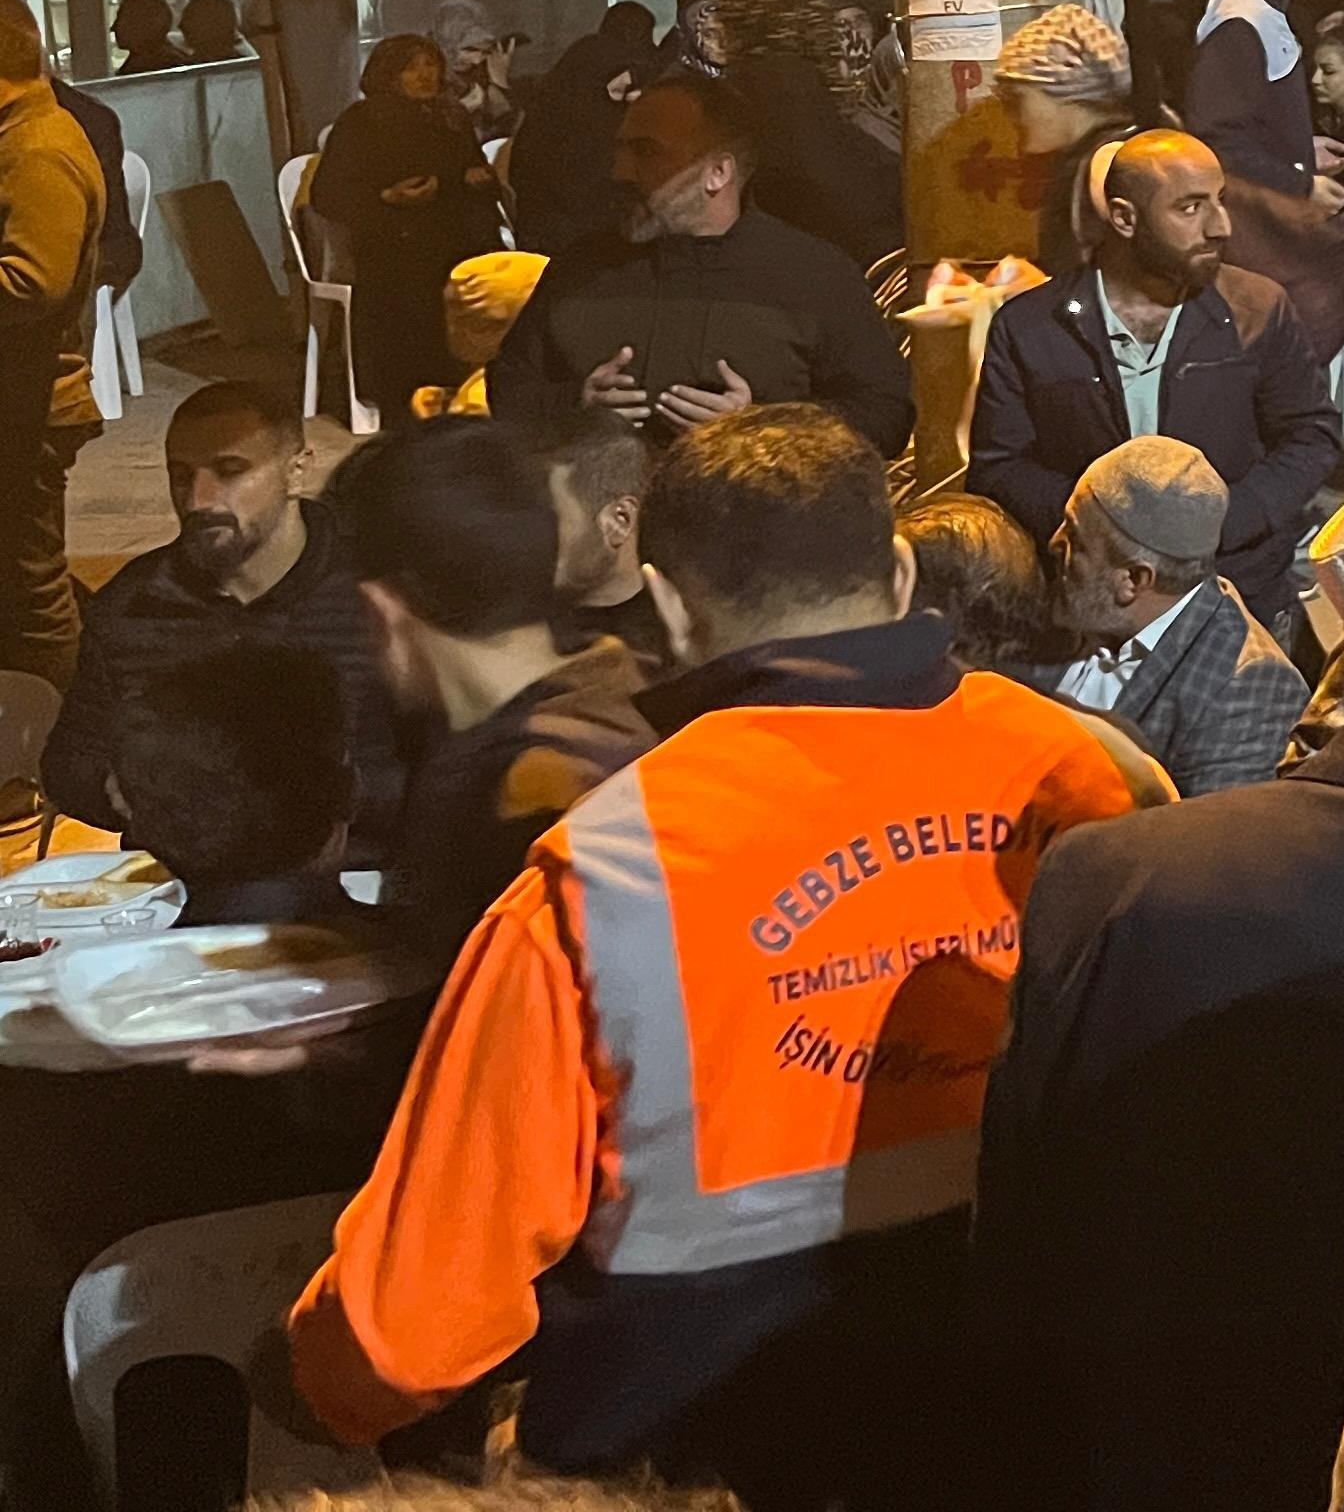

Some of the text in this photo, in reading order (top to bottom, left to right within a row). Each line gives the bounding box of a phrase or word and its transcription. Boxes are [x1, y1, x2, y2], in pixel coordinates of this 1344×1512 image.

[751, 835, 882, 953] GEBZE
[767, 944, 897, 1005] TEMİZLİK
[774, 1014, 843, 1077] İŞİN
